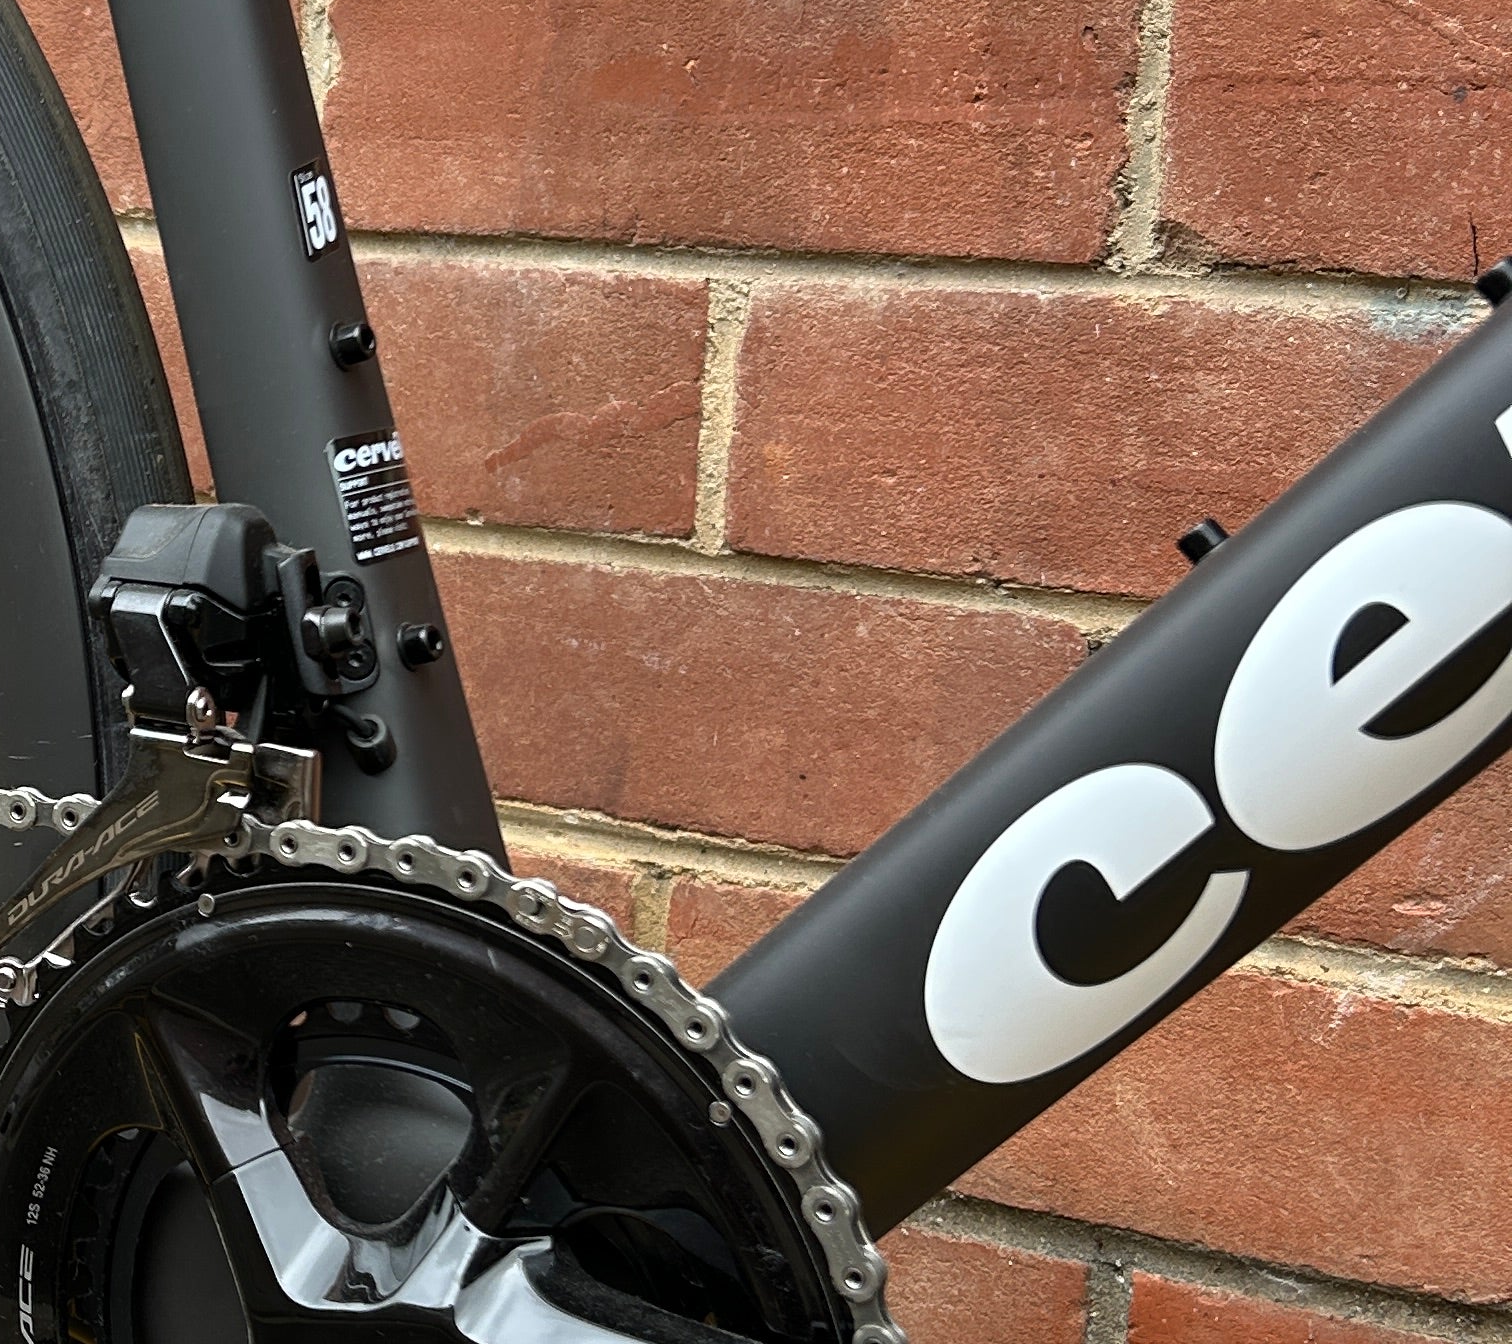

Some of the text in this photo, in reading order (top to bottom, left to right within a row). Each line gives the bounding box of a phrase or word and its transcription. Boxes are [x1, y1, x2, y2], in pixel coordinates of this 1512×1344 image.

[301, 176, 337, 250] 58
[924, 404, 1512, 1084] ce
[7, 789, 160, 926] DURA-ACE
[26, 1146, 58, 1225] 12S 52-36 NH
